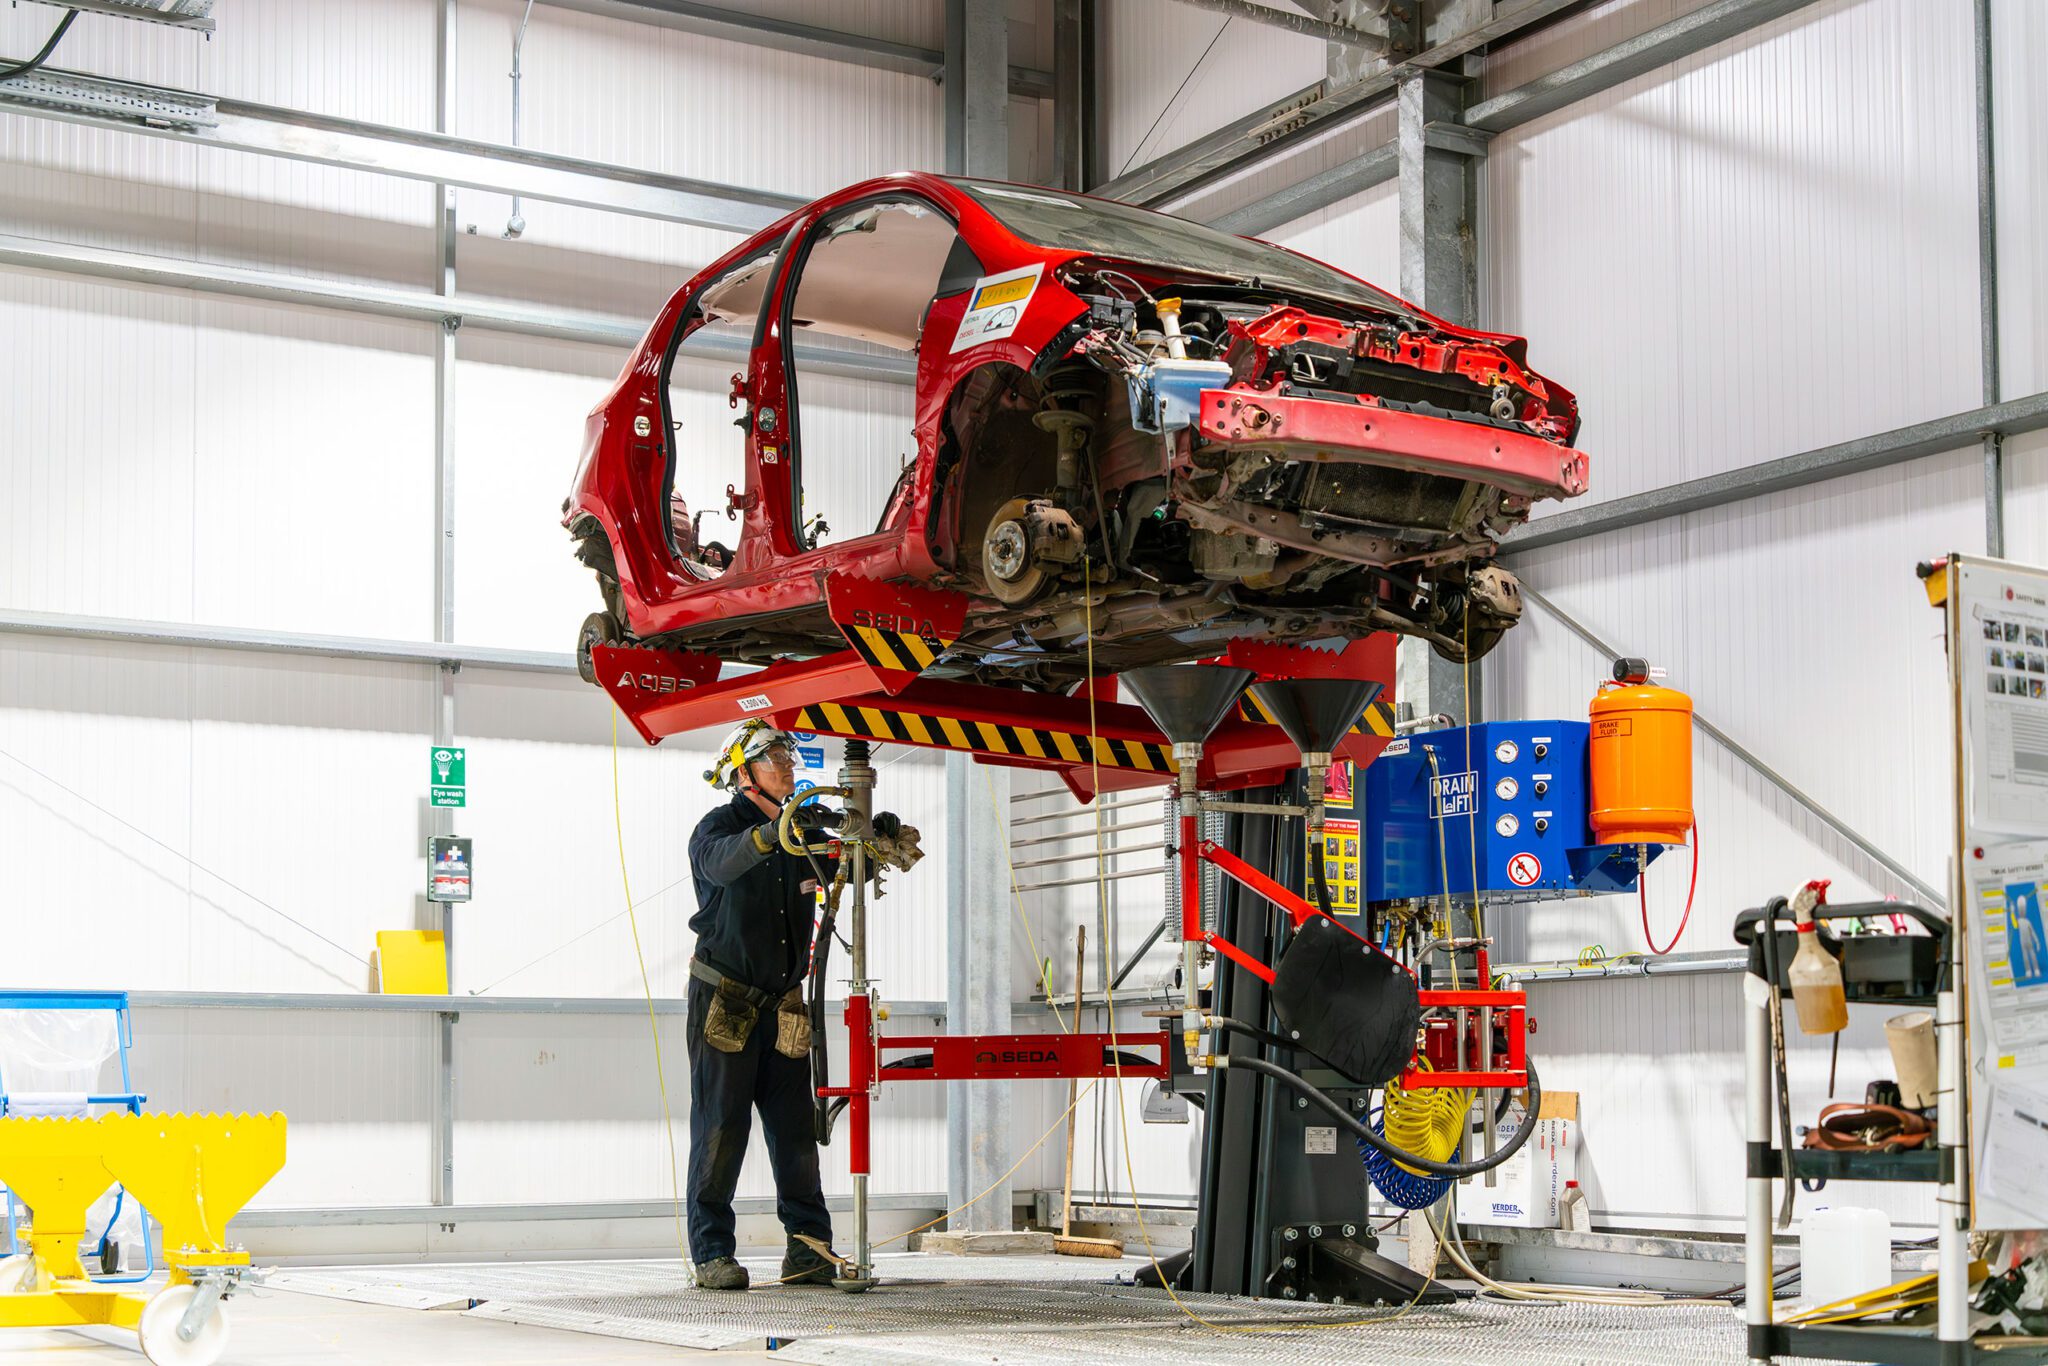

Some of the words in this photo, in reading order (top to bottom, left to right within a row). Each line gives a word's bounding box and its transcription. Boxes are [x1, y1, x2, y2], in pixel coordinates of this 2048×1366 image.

[853, 610, 937, 638] SEDA
[757, 697, 769, 707] kg
[1388, 743, 1409, 752] SEDA
[1432, 775, 1475, 797] DRAIN
[433, 789, 446, 798] Eye
[446, 790, 464, 798] wash
[1442, 795, 1470, 814] LIFT
[1001, 1050, 1059, 1063] SEDA
[1491, 1203, 1518, 1211] VERDER
